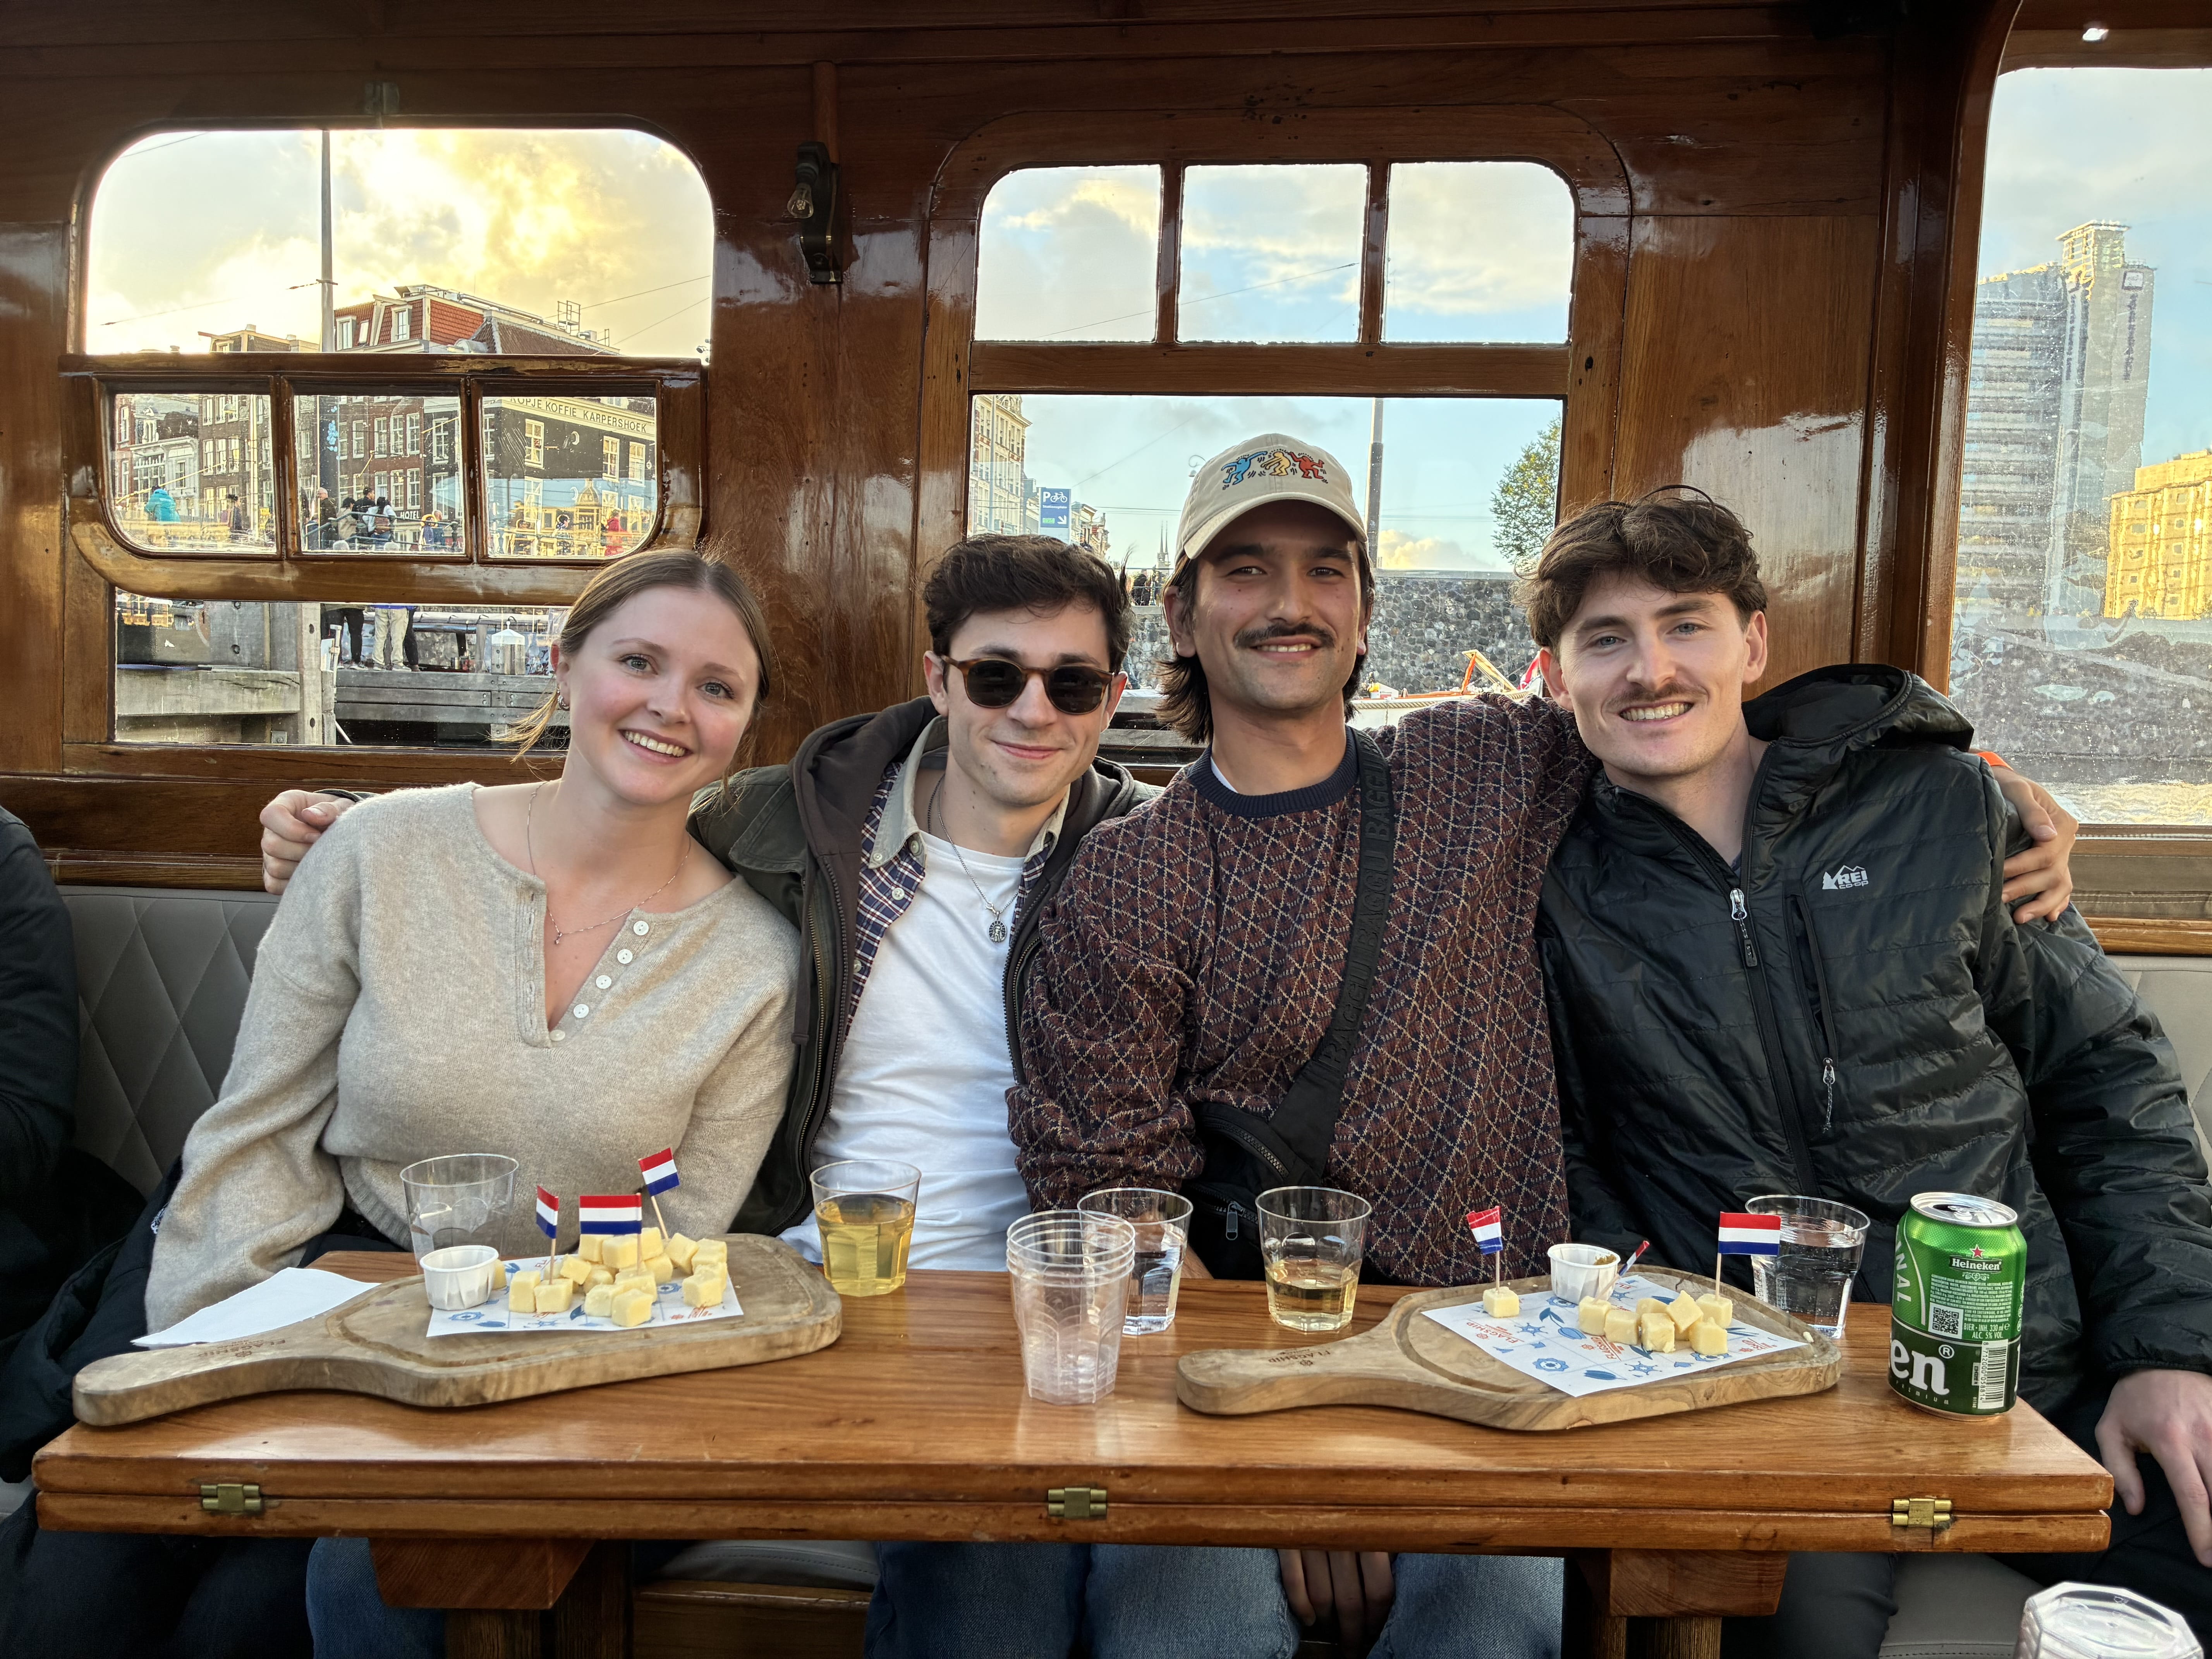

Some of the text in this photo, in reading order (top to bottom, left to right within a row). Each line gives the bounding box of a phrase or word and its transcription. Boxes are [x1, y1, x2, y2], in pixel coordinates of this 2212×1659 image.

[546, 400, 576, 417] KOFFIE
[583, 410, 647, 433] KARPERSHOEK
[1043, 491, 1051, 502] P
[400, 510, 420, 520] HOTEL
[1838, 870, 1868, 885] REI
[1895, 1224, 1911, 1302] INAL
[1952, 1258, 2001, 1270] Heineken
[1466, 1322, 1518, 1343] FLAGSHIP
